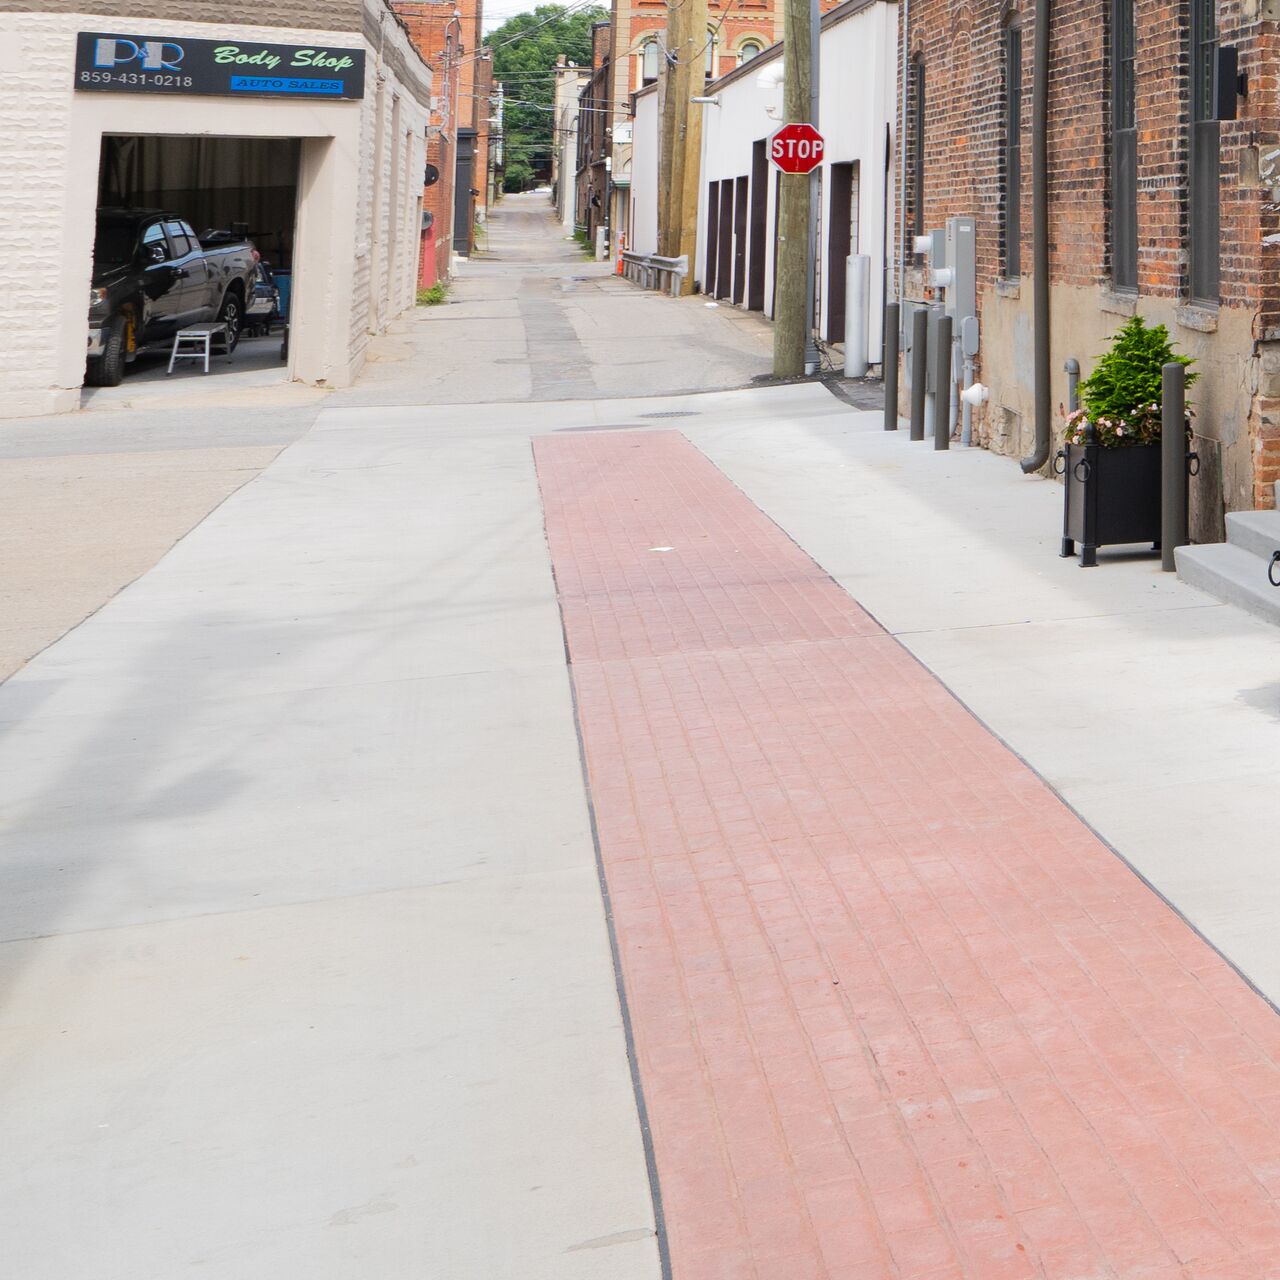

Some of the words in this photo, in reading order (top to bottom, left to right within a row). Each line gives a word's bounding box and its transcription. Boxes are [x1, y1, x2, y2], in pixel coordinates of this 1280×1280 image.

[214, 46, 281, 68] Body
[290, 50, 354, 71] Shop
[80, 71, 193, 87] 859-431-0218
[236, 79, 283, 89] AUTO
[288, 80, 339, 90] SALES
[772, 139, 823, 158] STOP
